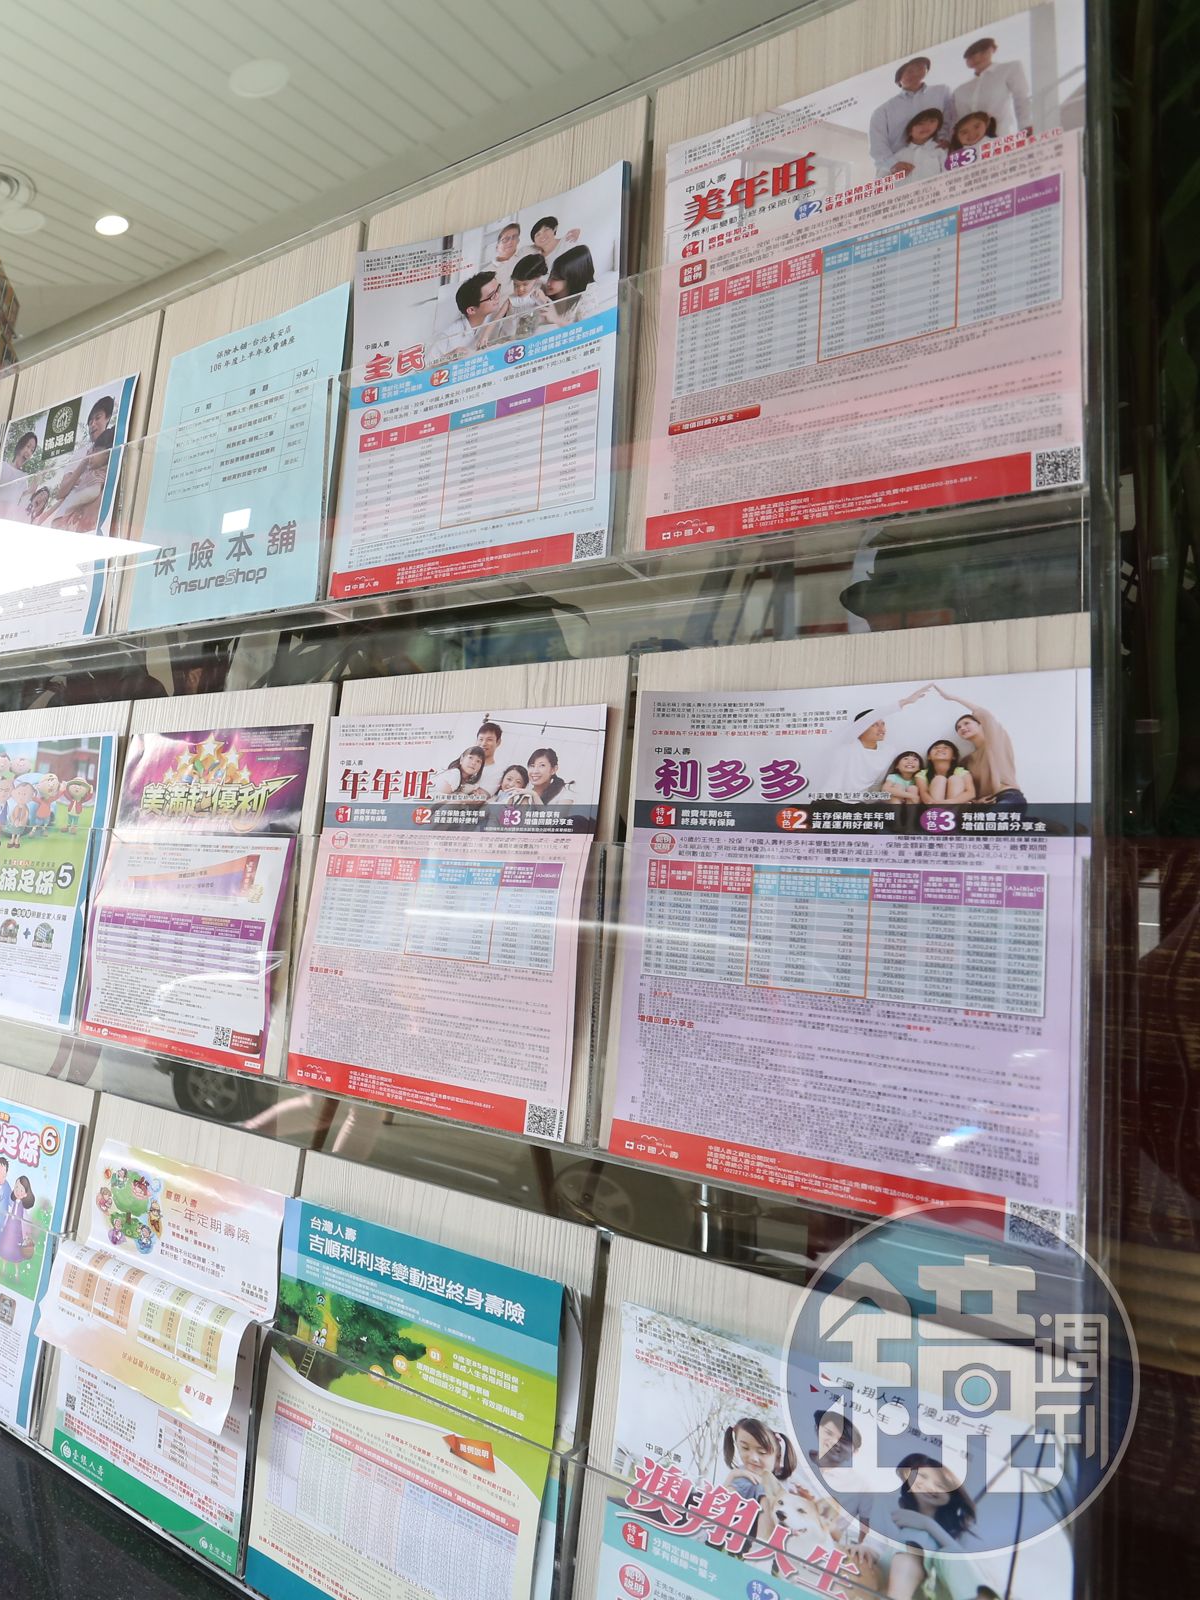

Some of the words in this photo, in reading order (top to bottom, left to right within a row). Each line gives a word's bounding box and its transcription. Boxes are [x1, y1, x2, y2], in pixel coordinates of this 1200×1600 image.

[683, 152, 816, 231] 美年旺
[685, 173, 727, 194] 中國人壽
[210, 362, 222, 373] 106
[363, 344, 426, 383] 全民
[153, 519, 297, 578] 保險本舖
[169, 566, 268, 596] insureShop
[654, 746, 691, 756] 中國人壽
[339, 759, 363, 767] 中國人壽
[339, 768, 436, 802] 年年旺
[654, 758, 809, 801] 利多多
[141, 781, 270, 820] 美滿超優利
[525, 810, 560, 819] 有機會享有
[681, 809, 733, 818] 繳費年期6年
[681, 817, 736, 827] 終身享有保障
[812, 811, 896, 822] 生存保險金年年領
[962, 811, 1022, 822] 有機會享有
[812, 820, 884, 831] 資產運用好便利
[961, 821, 1047, 833] 增值回饋分享金
[636, 1143, 679, 1160] 中國人壽
[171, 1206, 251, 1244] 一年定期壽險
[309, 1216, 357, 1242] 台灣人壽
[308, 1233, 526, 1326] 吉順利利率變動型終身壽險
[645, 1441, 682, 1464] 中國人壽
[618, 1457, 861, 1600] 澳翔人生
